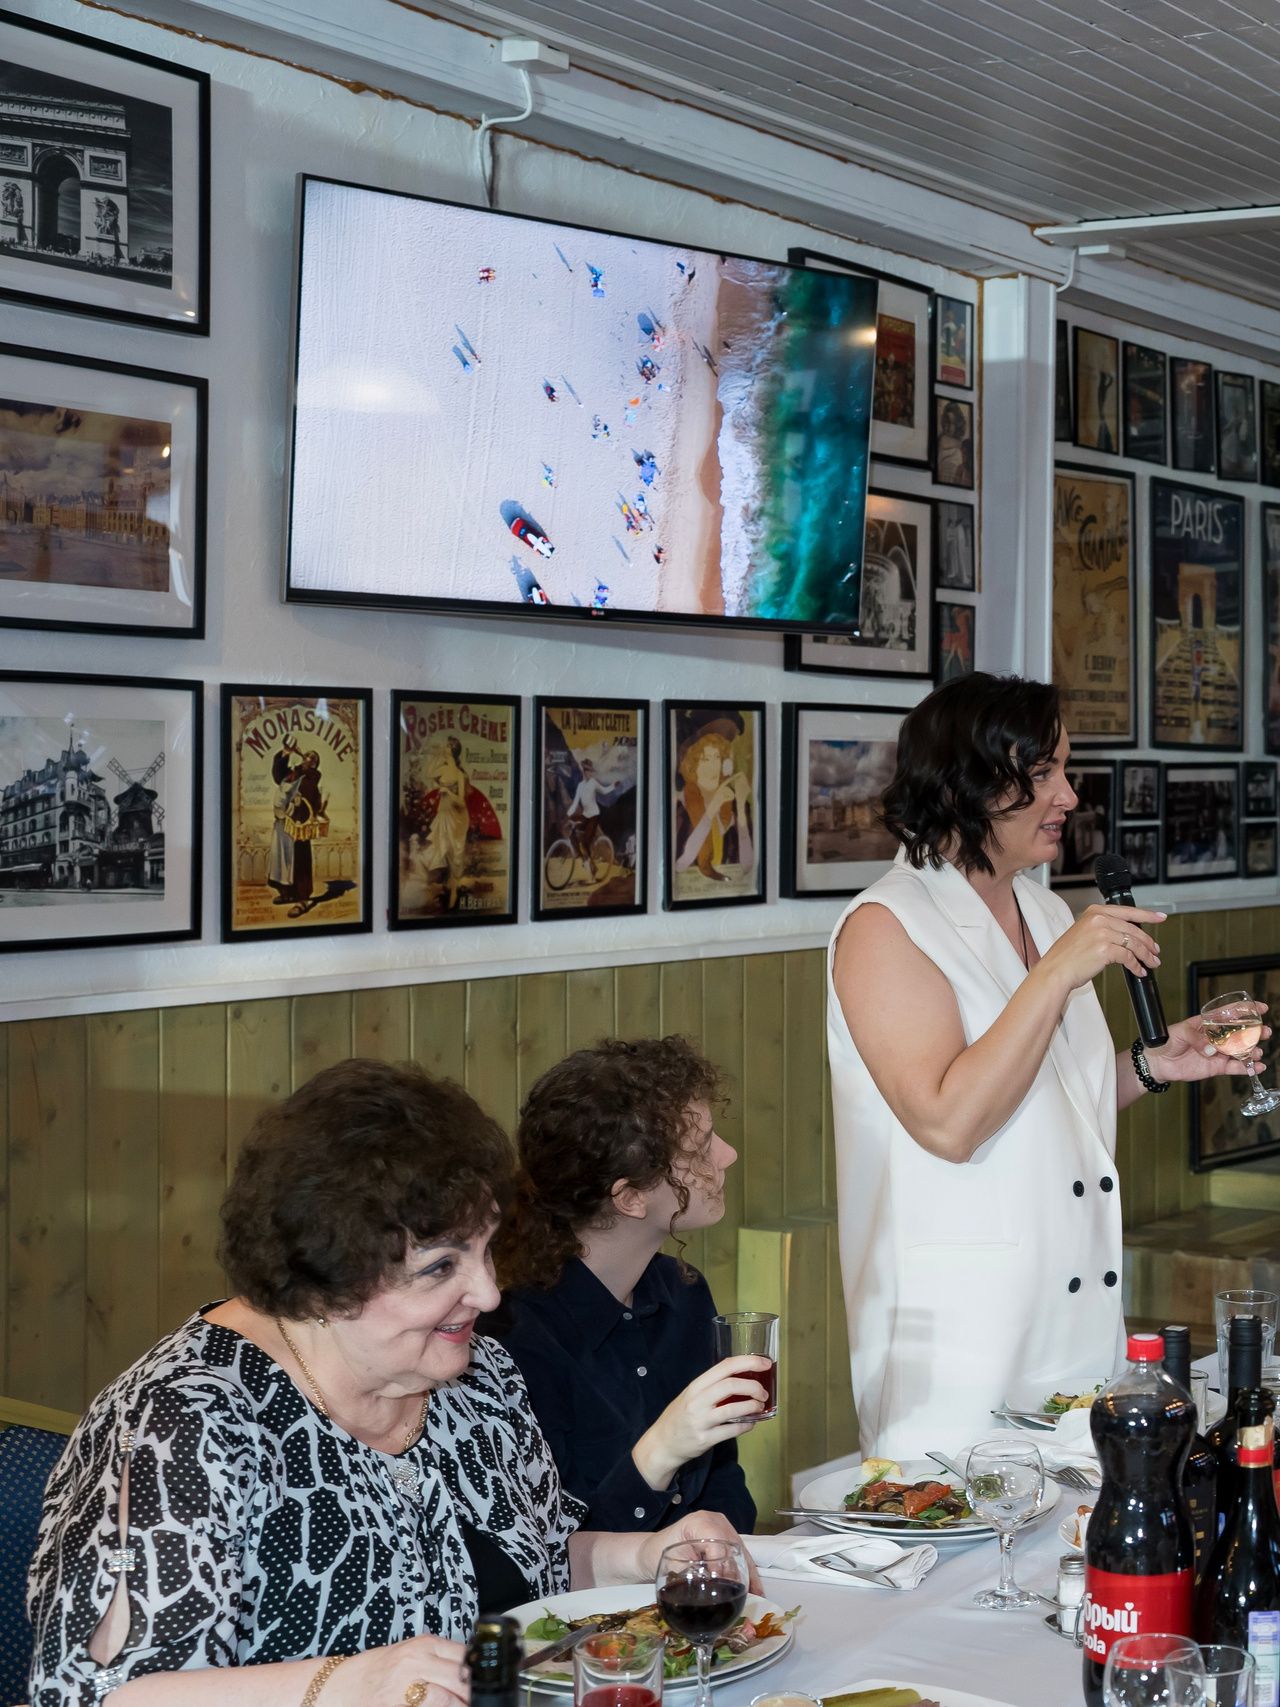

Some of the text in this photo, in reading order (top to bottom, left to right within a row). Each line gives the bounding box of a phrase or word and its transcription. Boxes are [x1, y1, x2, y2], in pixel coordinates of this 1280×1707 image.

[1171, 494, 1224, 544] PARIS
[404, 705, 455, 753] ROSÉE
[561, 711, 571, 730] LA
